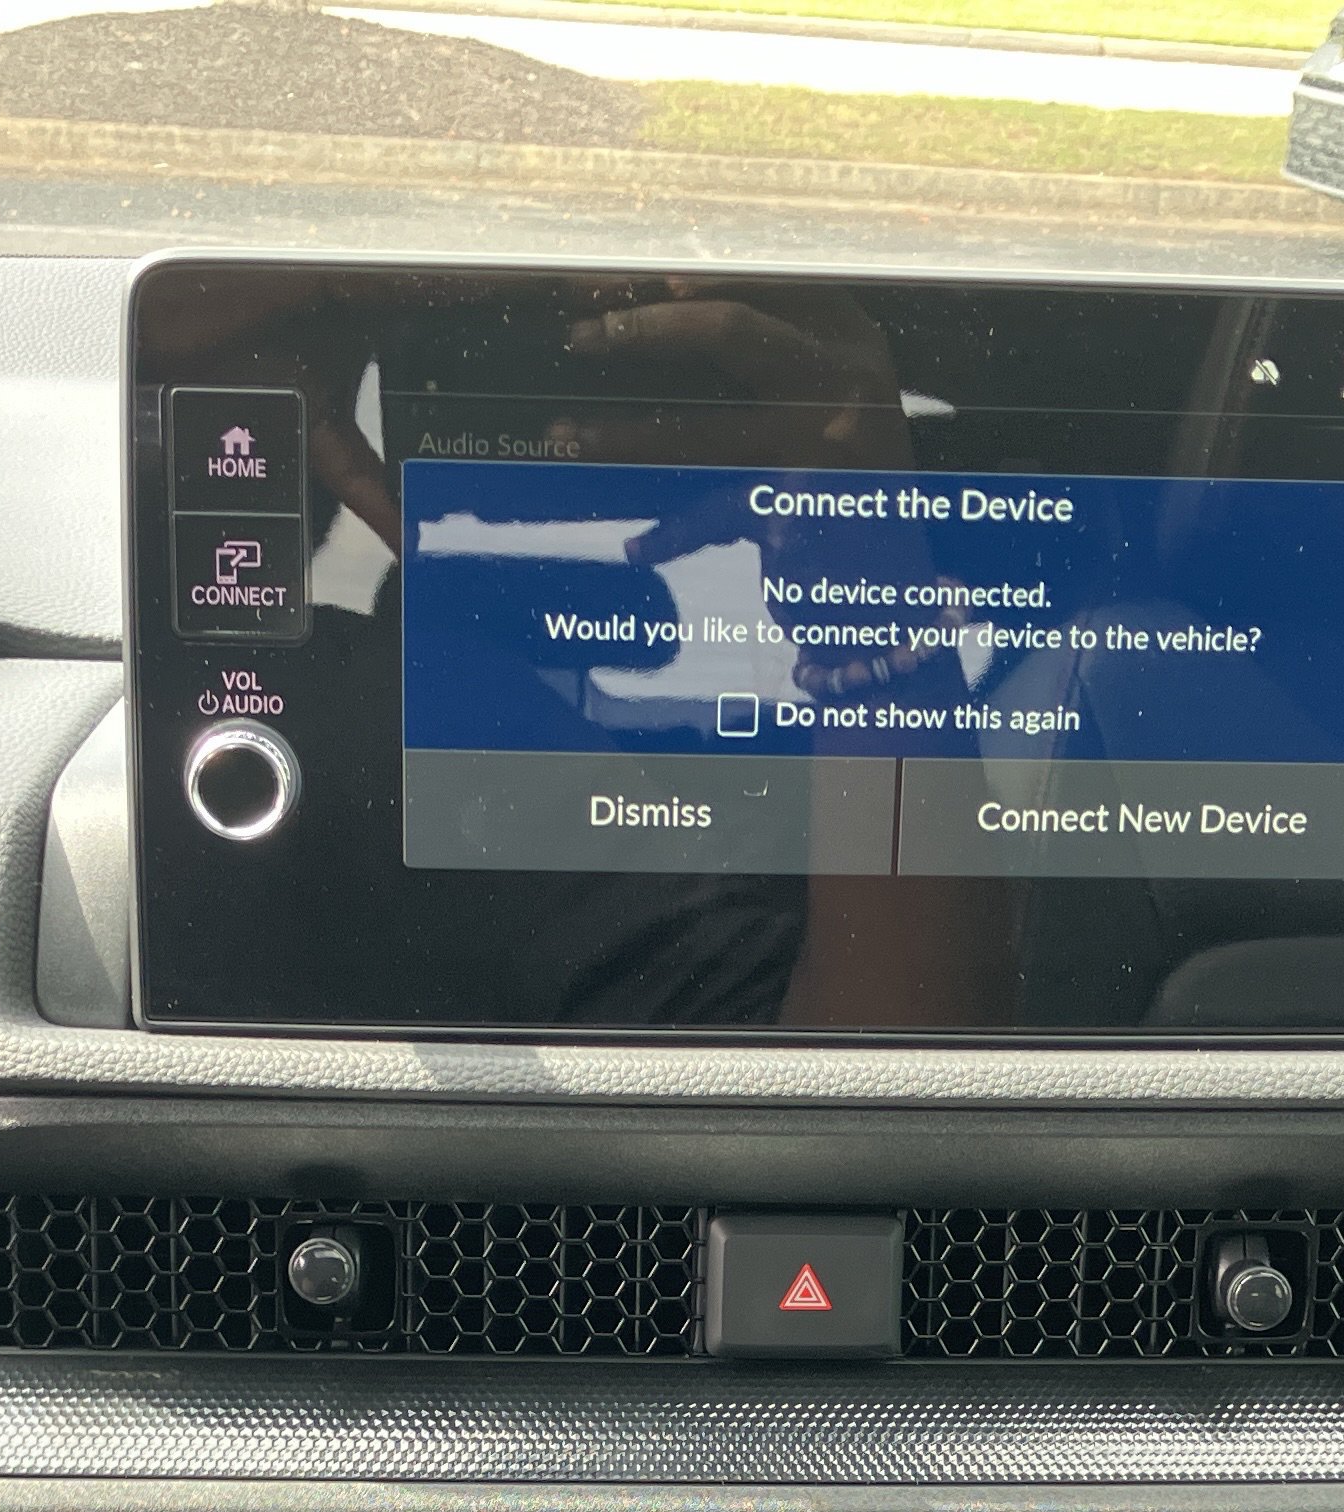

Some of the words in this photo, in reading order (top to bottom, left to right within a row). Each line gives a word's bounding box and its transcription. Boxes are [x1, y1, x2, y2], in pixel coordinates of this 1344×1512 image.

[417, 431, 491, 458] Audio
[497, 434, 581, 459] Source
[207, 457, 267, 479] HOME
[749, 484, 889, 519] Connect
[896, 486, 951, 520] the
[960, 489, 1075, 523] Device
[190, 585, 288, 608] CONNECT
[761, 577, 804, 604] No
[809, 577, 898, 606] device
[903, 581, 1053, 609] connected.
[545, 612, 636, 642] Would
[642, 621, 695, 650] you
[702, 616, 749, 643] like
[756, 619, 785, 644] to
[791, 620, 901, 650] connect
[907, 626, 971, 653] your
[976, 620, 1063, 650] device
[1068, 624, 1098, 650] to
[1104, 622, 1150, 651] the
[1155, 625, 1263, 653] vehicle?
[220, 670, 263, 692] VOL
[221, 694, 285, 716] AUDIO
[775, 700, 817, 728] Do
[823, 702, 870, 729] not
[874, 701, 947, 730] show
[952, 703, 1003, 731] this
[1008, 708, 1081, 736] again
[589, 794, 713, 829] Dismiss
[977, 801, 1110, 834] Connect
[1118, 802, 1193, 834] New
[1199, 804, 1309, 835] Device
